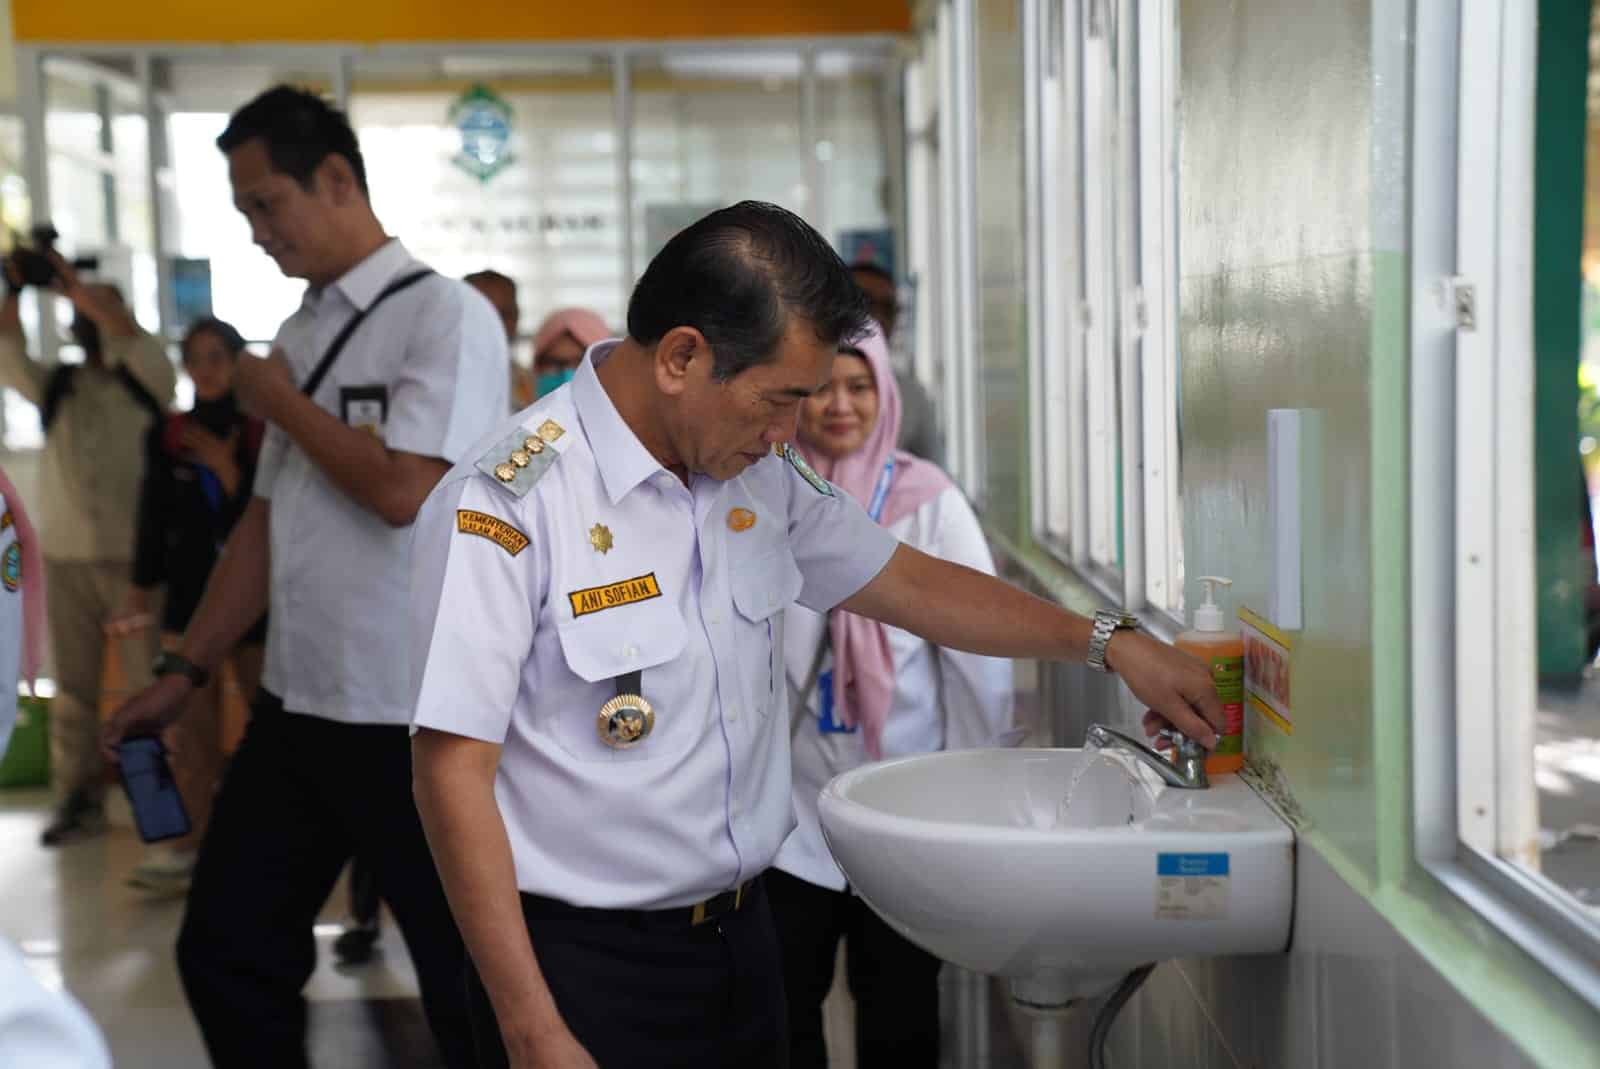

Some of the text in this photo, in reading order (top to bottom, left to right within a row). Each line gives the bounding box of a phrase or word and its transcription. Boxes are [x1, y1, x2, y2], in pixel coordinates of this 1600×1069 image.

[462, 512, 524, 546] KEMENTERIAN
[463, 521, 491, 536] DALAM
[581, 579, 651, 611] ANI SOFIAN
